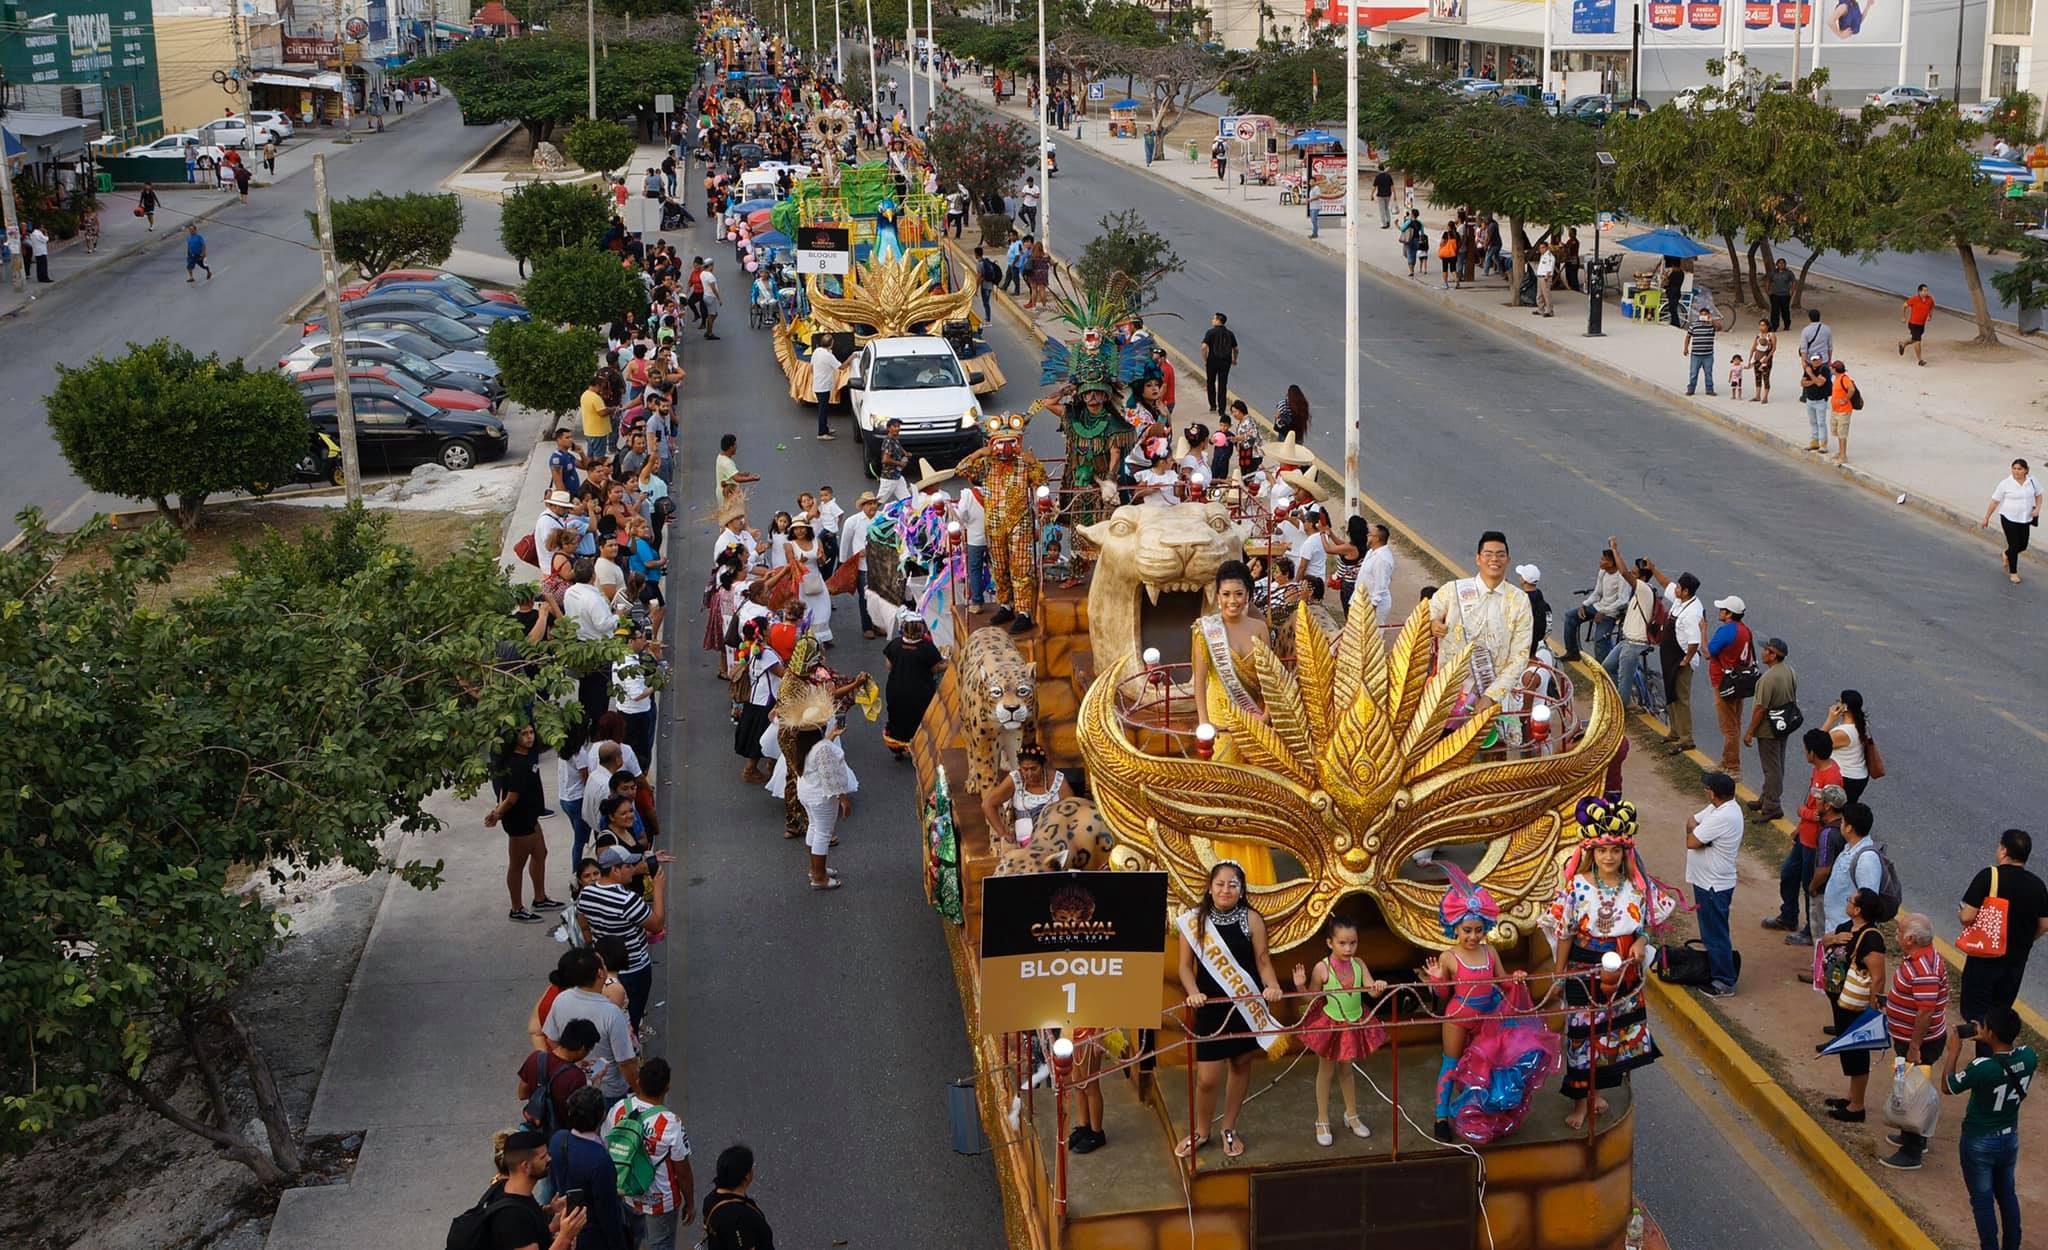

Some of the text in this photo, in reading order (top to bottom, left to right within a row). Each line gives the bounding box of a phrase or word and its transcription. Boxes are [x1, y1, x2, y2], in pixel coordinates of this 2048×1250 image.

[32, 52, 55, 65] CELULARES
[819, 259, 826, 269] 8
[1031, 920, 1116, 937] CARNAVAL
[1020, 957, 1124, 979] BLOQUE
[1061, 982, 1077, 1013] 1
